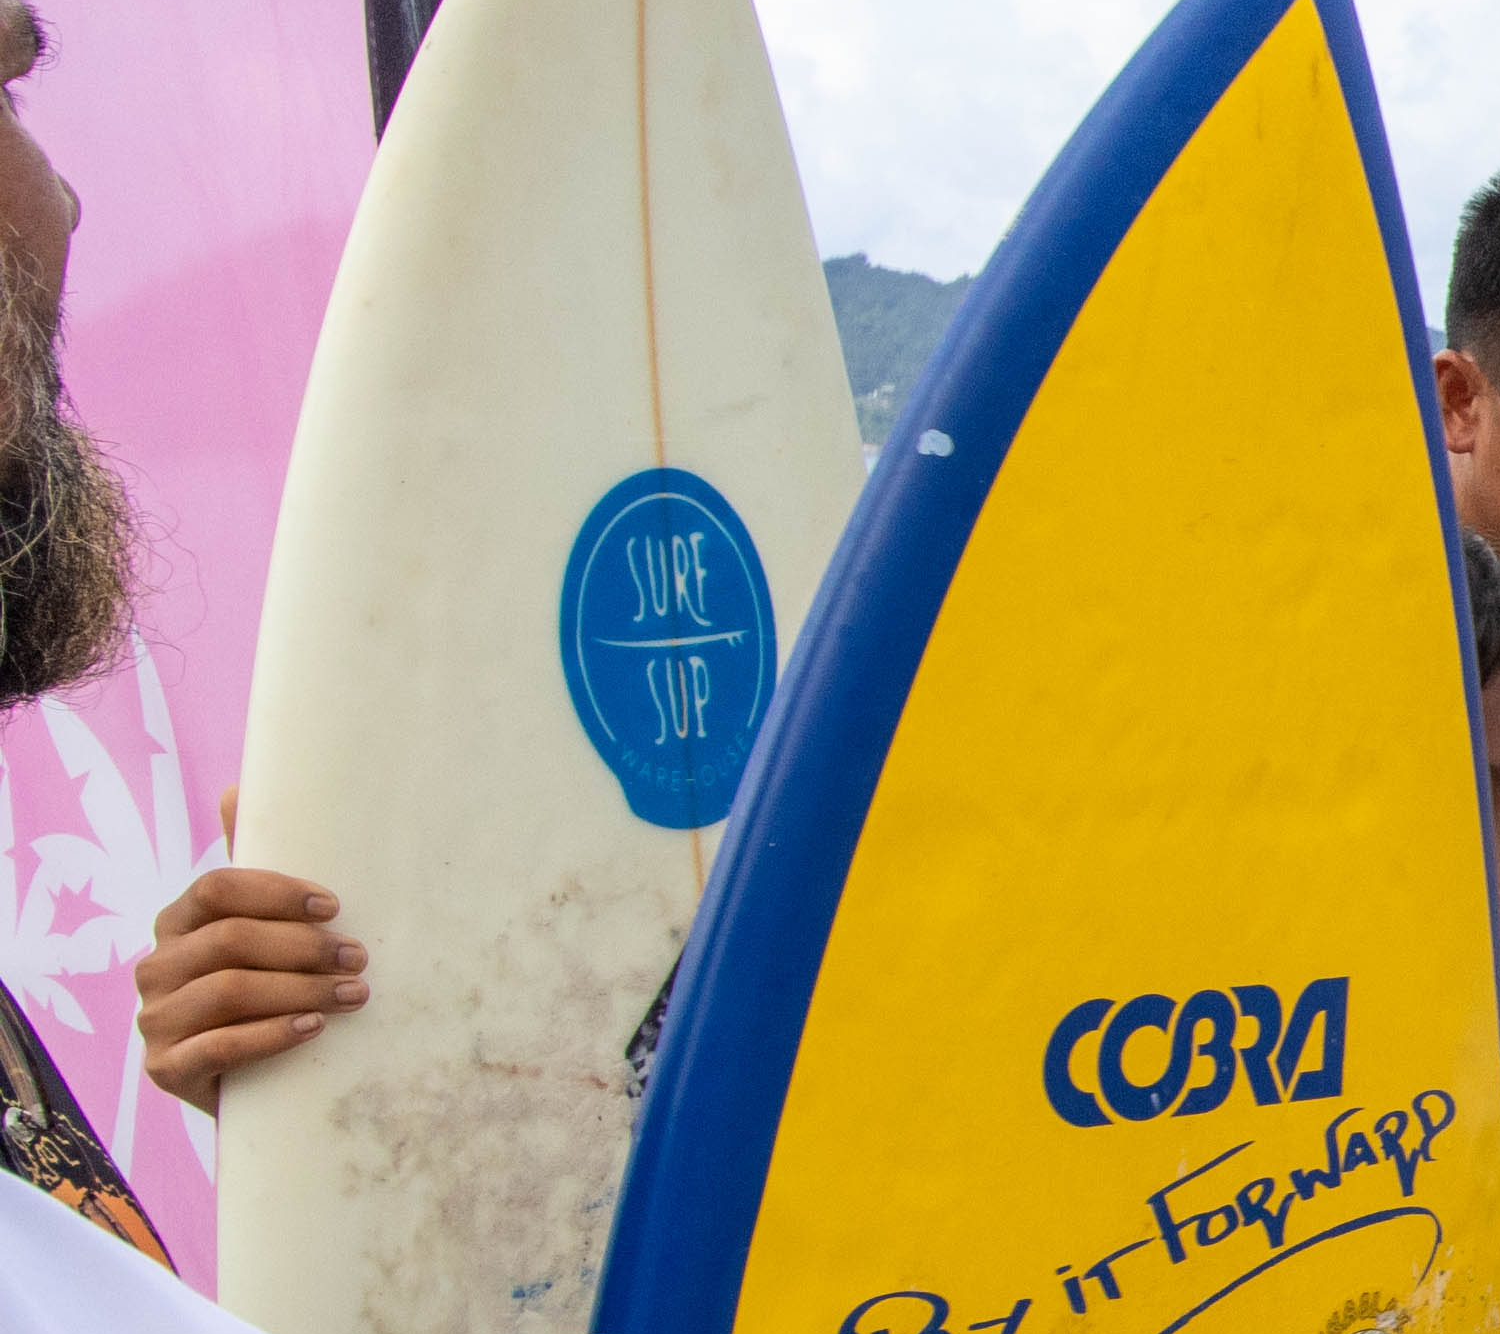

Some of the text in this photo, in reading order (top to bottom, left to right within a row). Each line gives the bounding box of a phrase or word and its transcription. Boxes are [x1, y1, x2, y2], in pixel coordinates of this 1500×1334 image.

[626, 531, 713, 627] SURF
[645, 655, 711, 746] SUP
[1042, 975, 1350, 1128] COBRA
